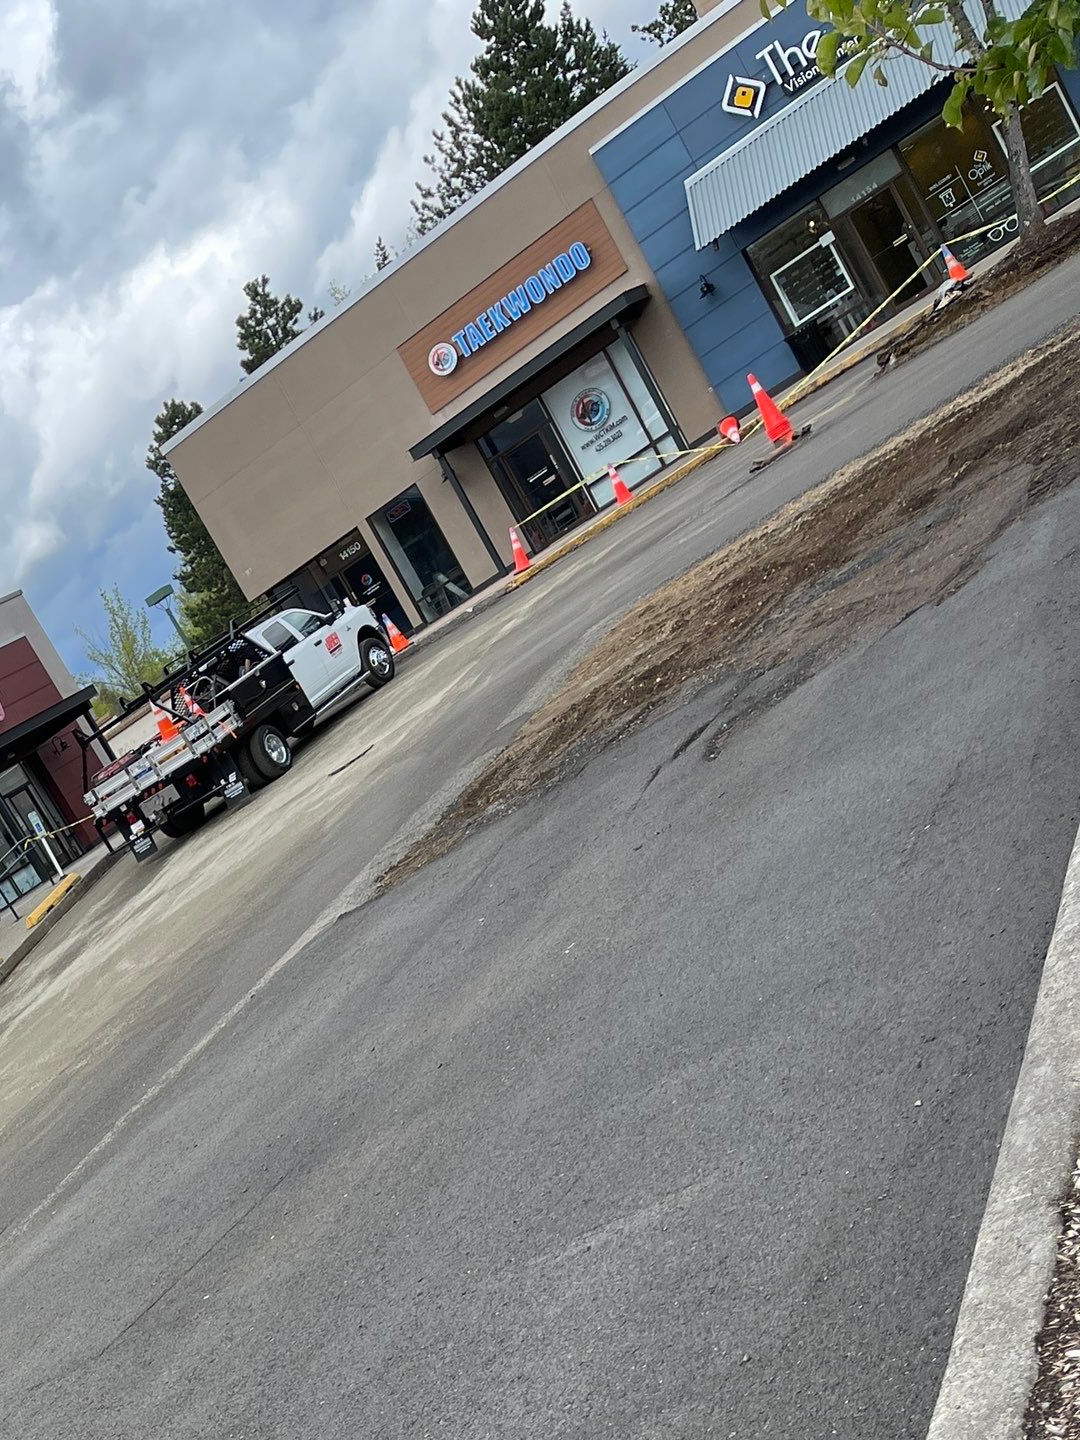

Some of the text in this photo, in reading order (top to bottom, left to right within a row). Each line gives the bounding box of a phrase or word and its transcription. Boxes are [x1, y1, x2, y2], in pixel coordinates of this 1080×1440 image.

[755, 30, 822, 86] The
[784, 65, 821, 92] Vision
[850, 182, 878, 203] 14154
[451, 241, 592, 358] TAEKWONDO
[339, 541, 362, 561] 14150
